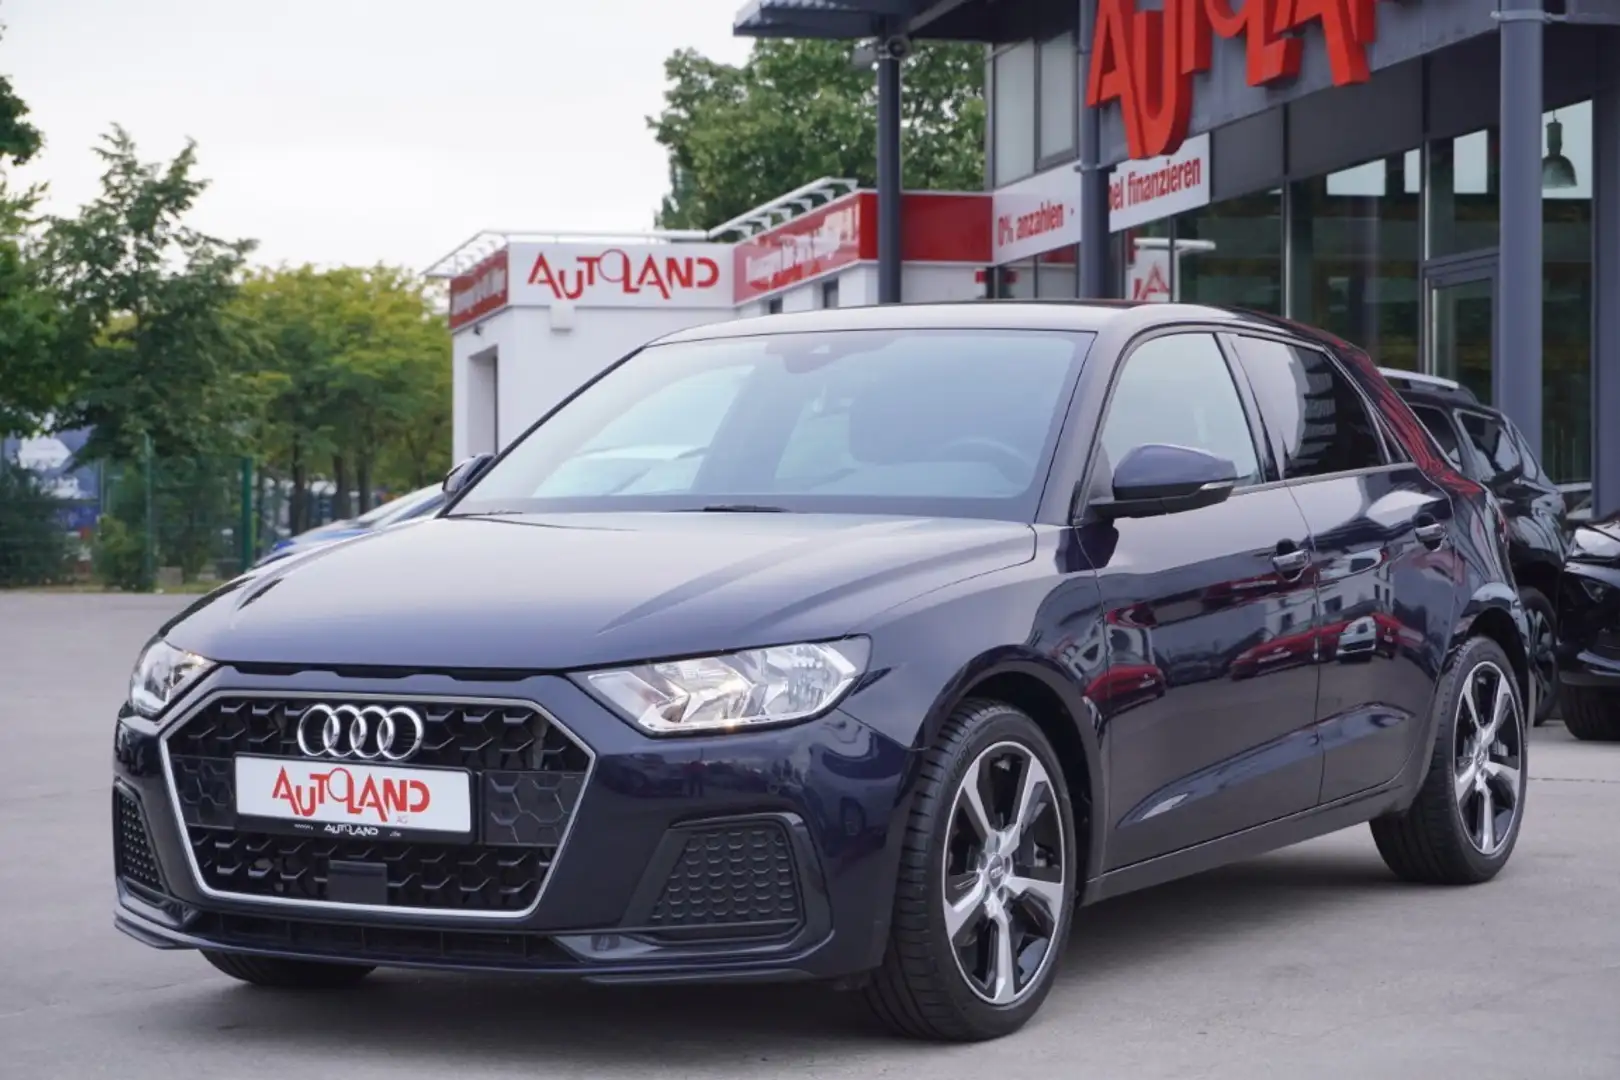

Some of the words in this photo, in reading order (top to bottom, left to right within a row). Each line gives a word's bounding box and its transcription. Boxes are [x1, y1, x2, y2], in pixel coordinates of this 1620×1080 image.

[1016, 200, 1065, 240] anzahlen
[1127, 157, 1201, 206] finanzieren
[527, 248, 720, 300] AUTOLAND
[272, 765, 431, 823] AUTOLAND
[323, 823, 379, 838] AUTOLAND
